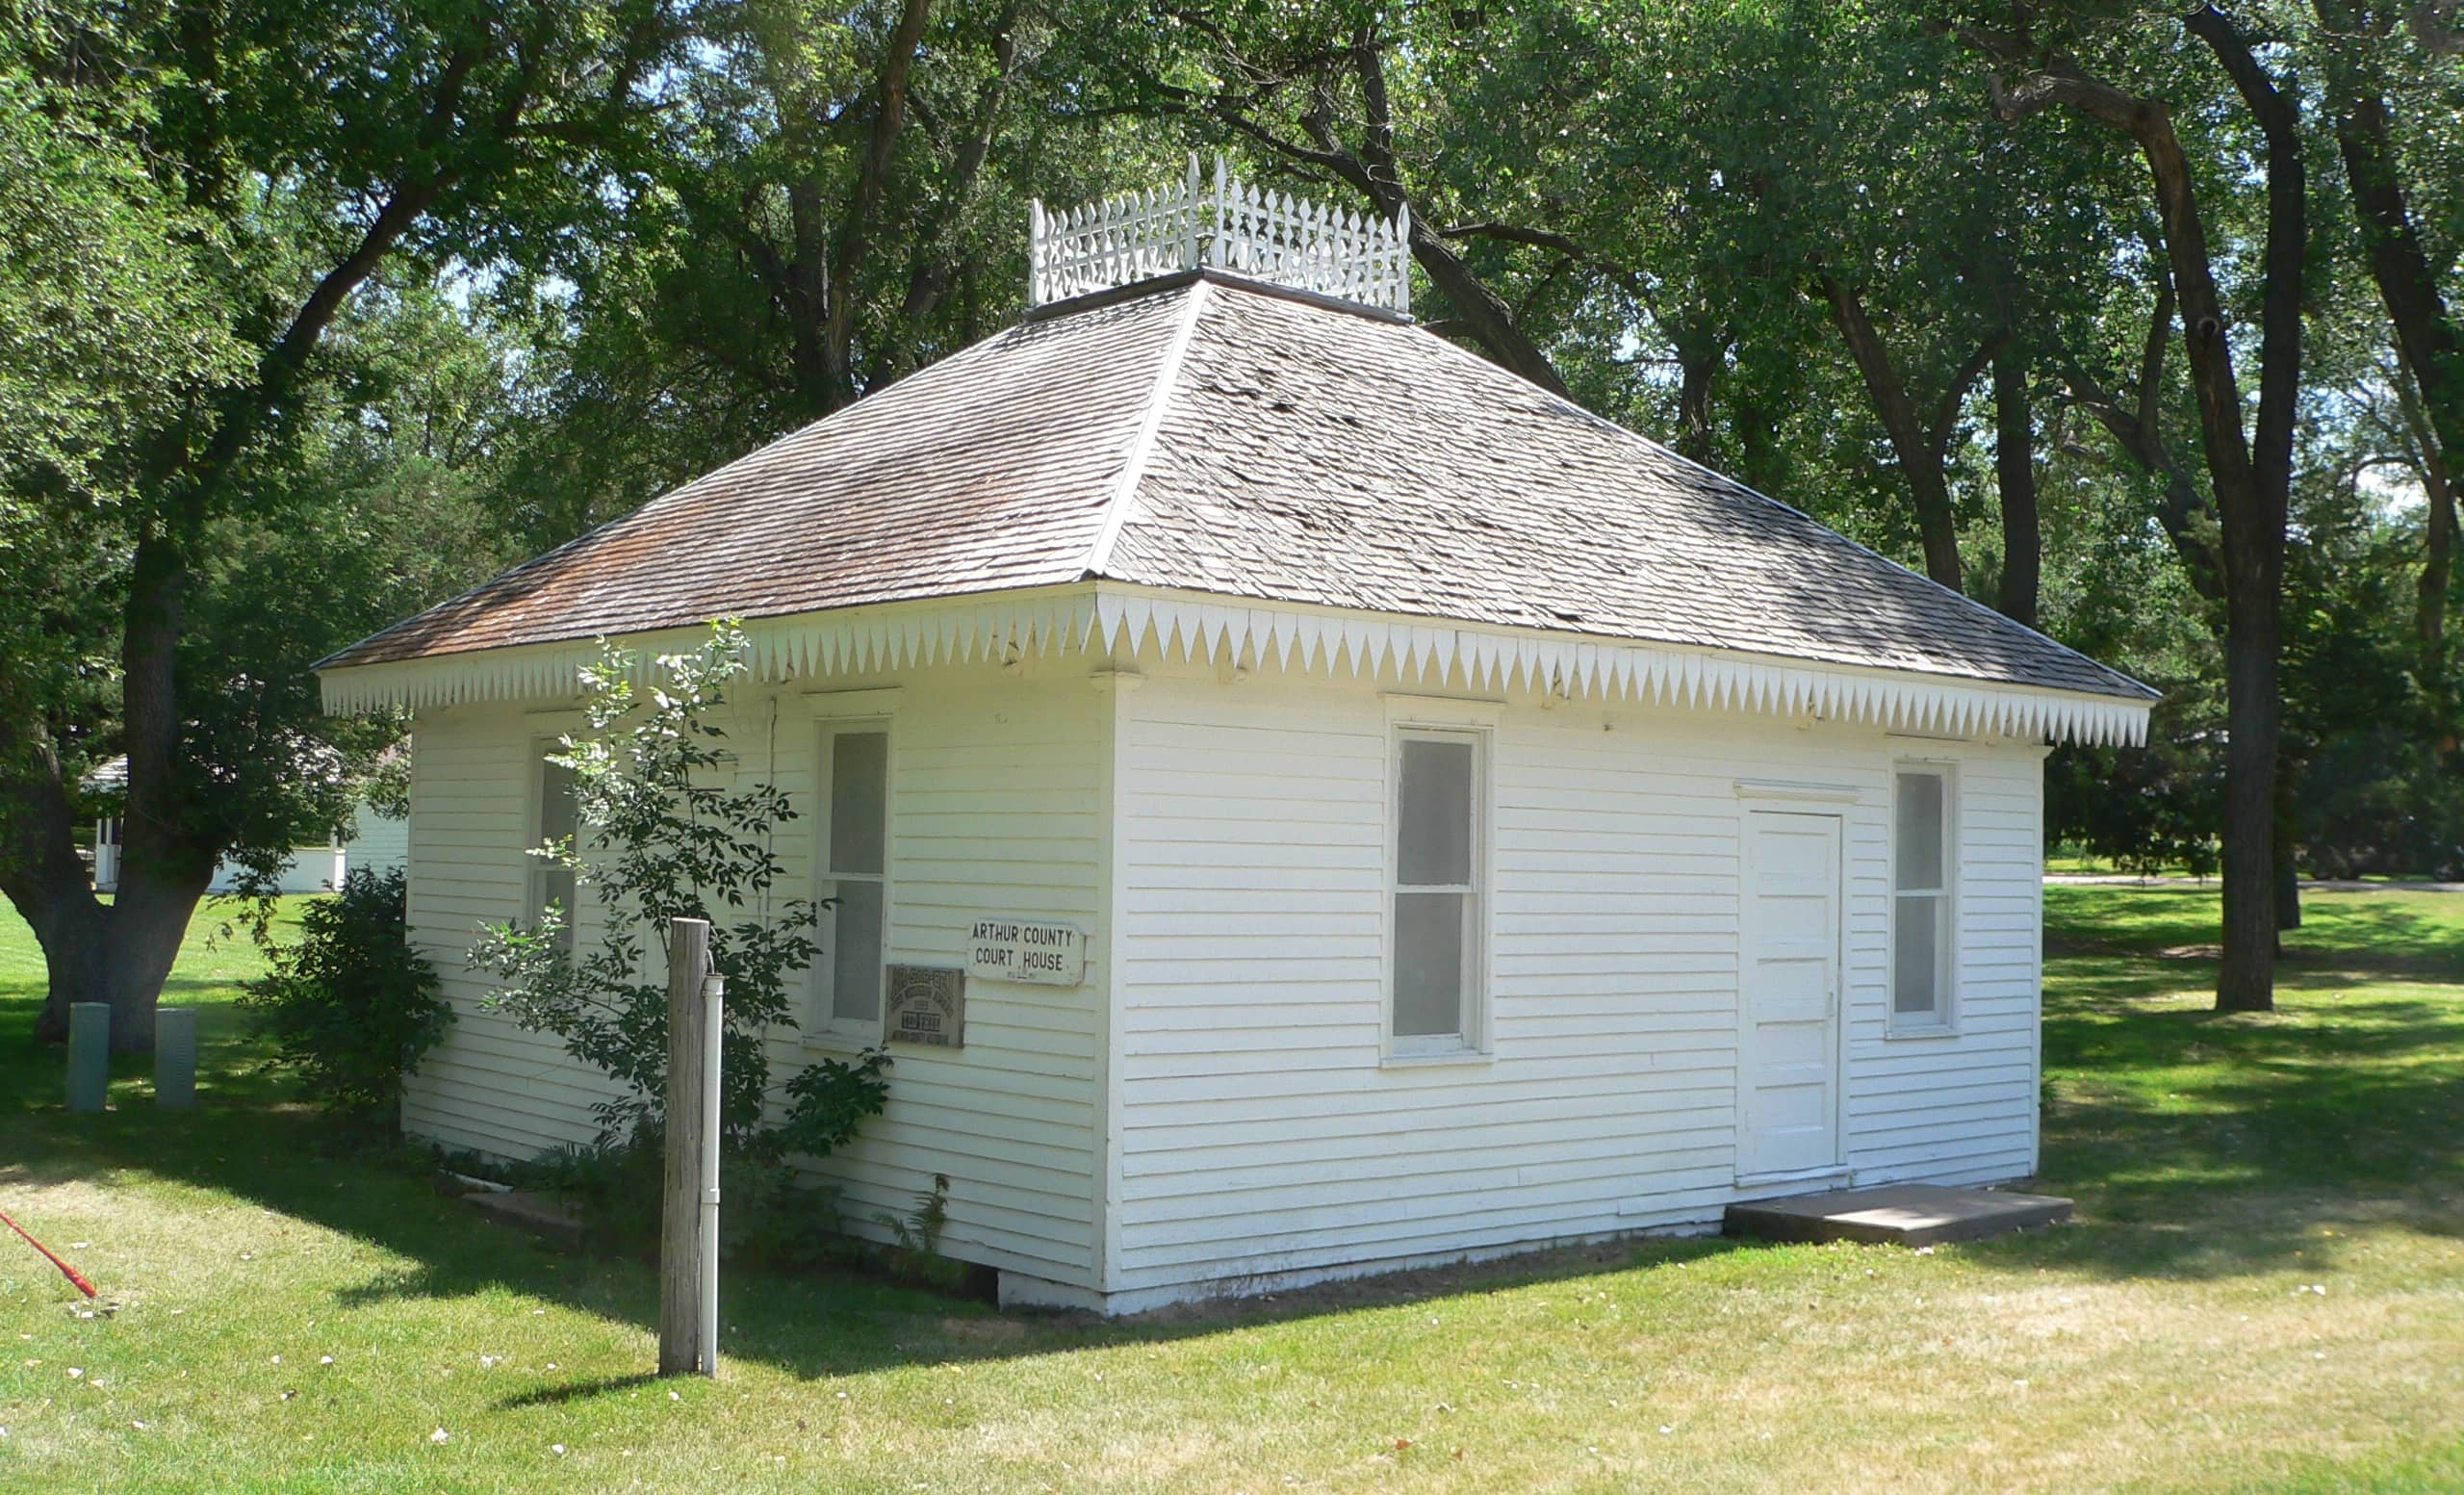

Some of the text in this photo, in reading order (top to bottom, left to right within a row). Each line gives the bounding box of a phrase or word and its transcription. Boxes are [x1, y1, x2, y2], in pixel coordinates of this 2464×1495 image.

[972, 922, 1072, 947] ARTHUR COUNTY
[976, 947, 1063, 971] COURT HOUSE
